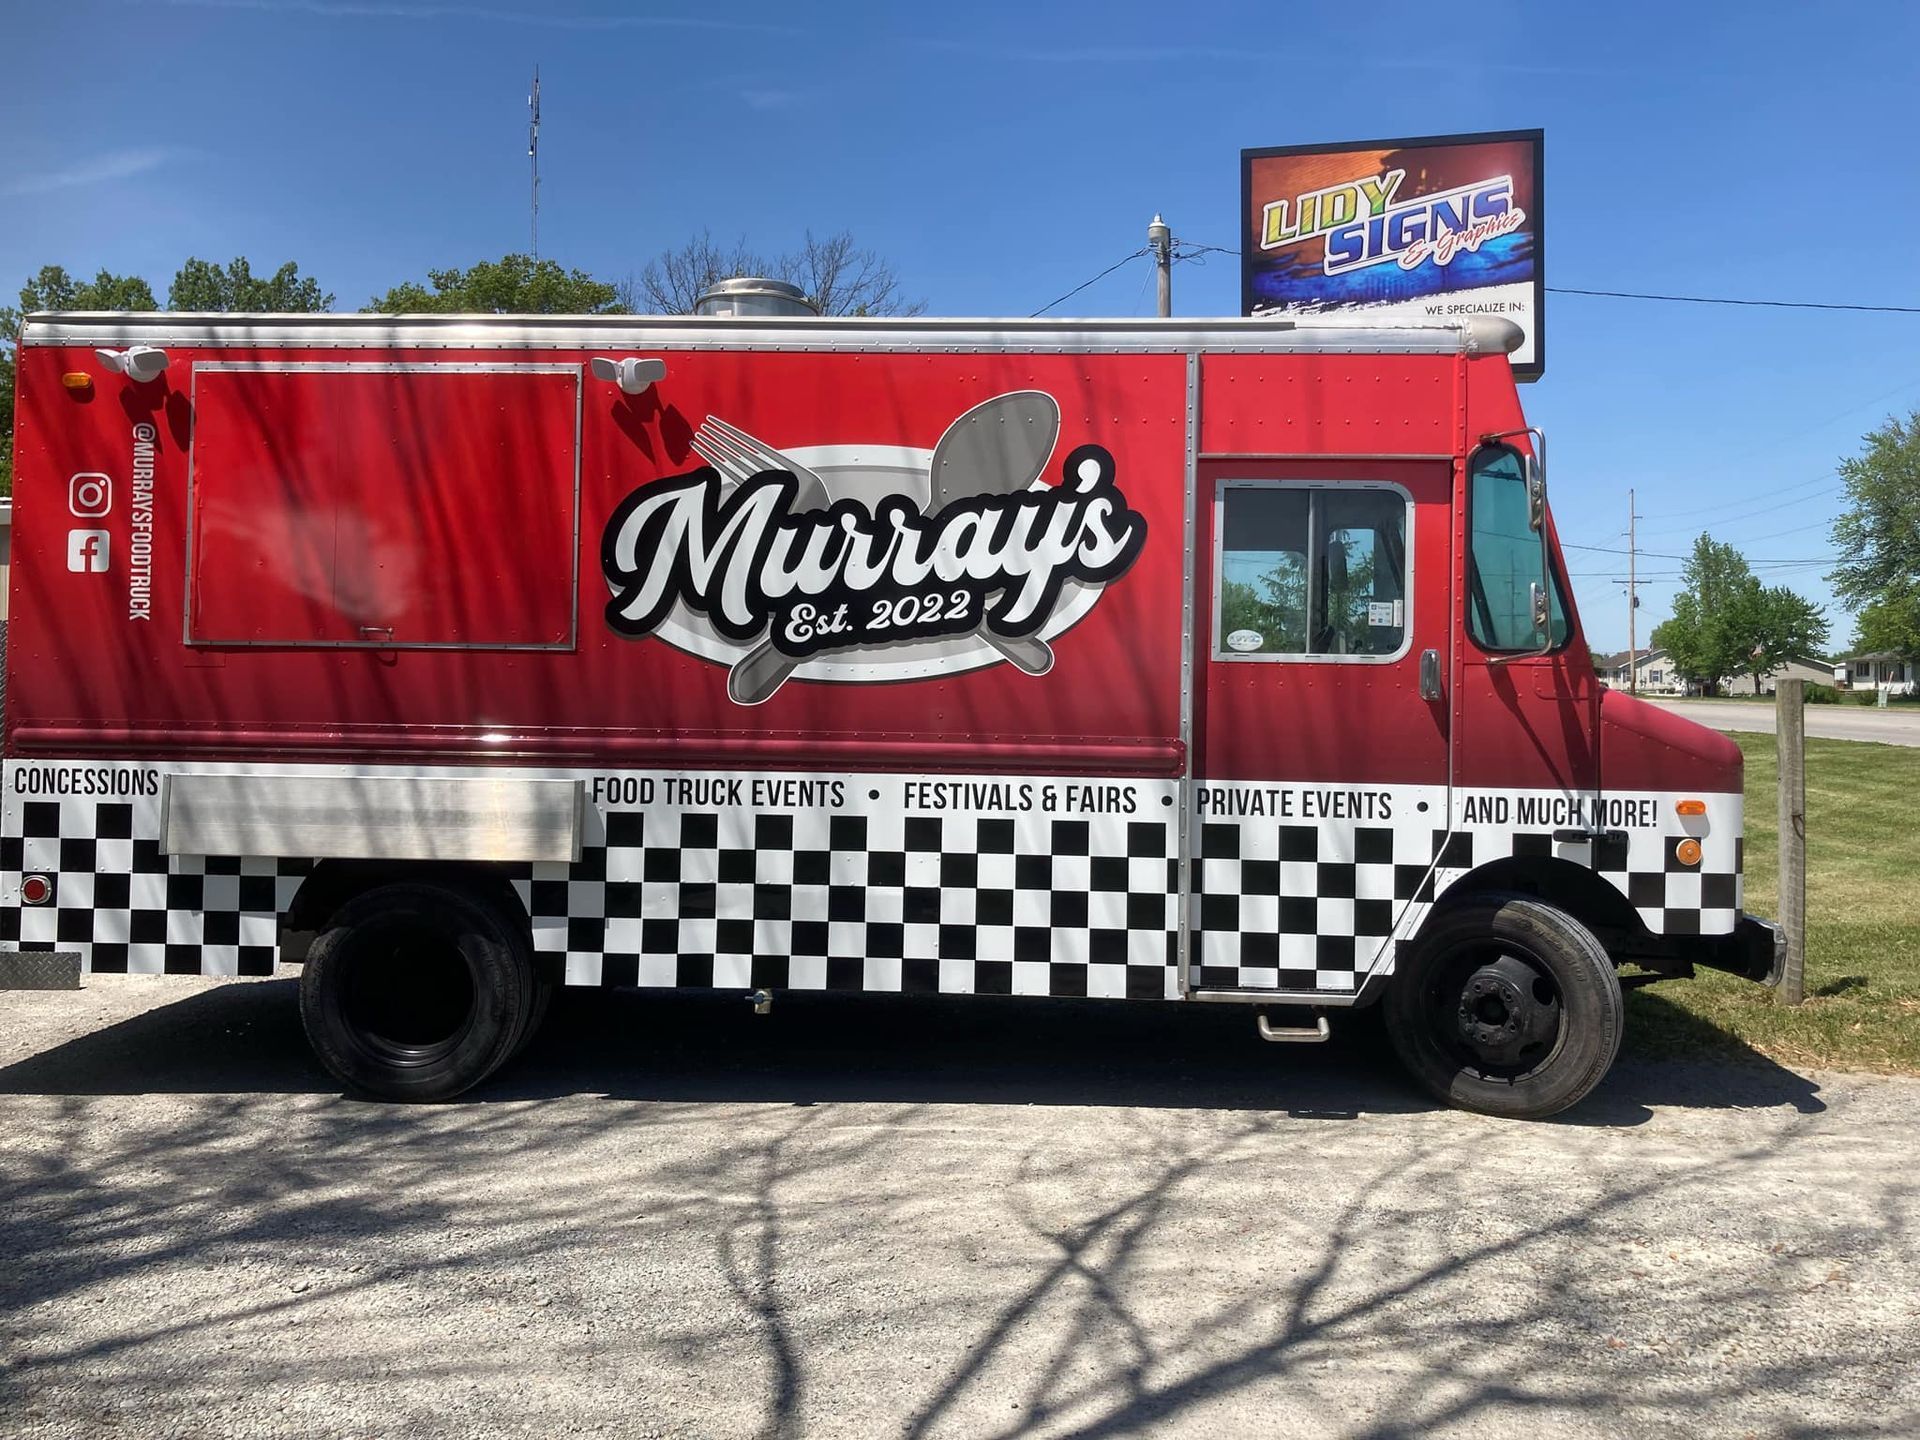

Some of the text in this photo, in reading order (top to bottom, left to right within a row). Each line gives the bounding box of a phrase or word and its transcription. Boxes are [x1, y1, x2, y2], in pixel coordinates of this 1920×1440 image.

[1265, 171, 1402, 245] LIDY
[1328, 186, 1510, 267] SIGNS
[1402, 212, 1518, 265] & Graphics
[1425, 302, 1525, 315] WE SPECIALIZE IN:
[129, 422, 156, 621] @MURRAYSFOODTRUCK
[616, 458, 1134, 626] Murray's
[786, 590, 972, 642] Est. 2022
[14, 767, 159, 796] CONCESSIONS
[592, 777, 845, 808] FOOD TRUCK EVENTS
[904, 782, 1137, 813] FESTIVALS & FAIRS
[1197, 788, 1392, 819] PRIVATE EVENTS
[1463, 796, 1657, 828] AND MUCH MORE!
